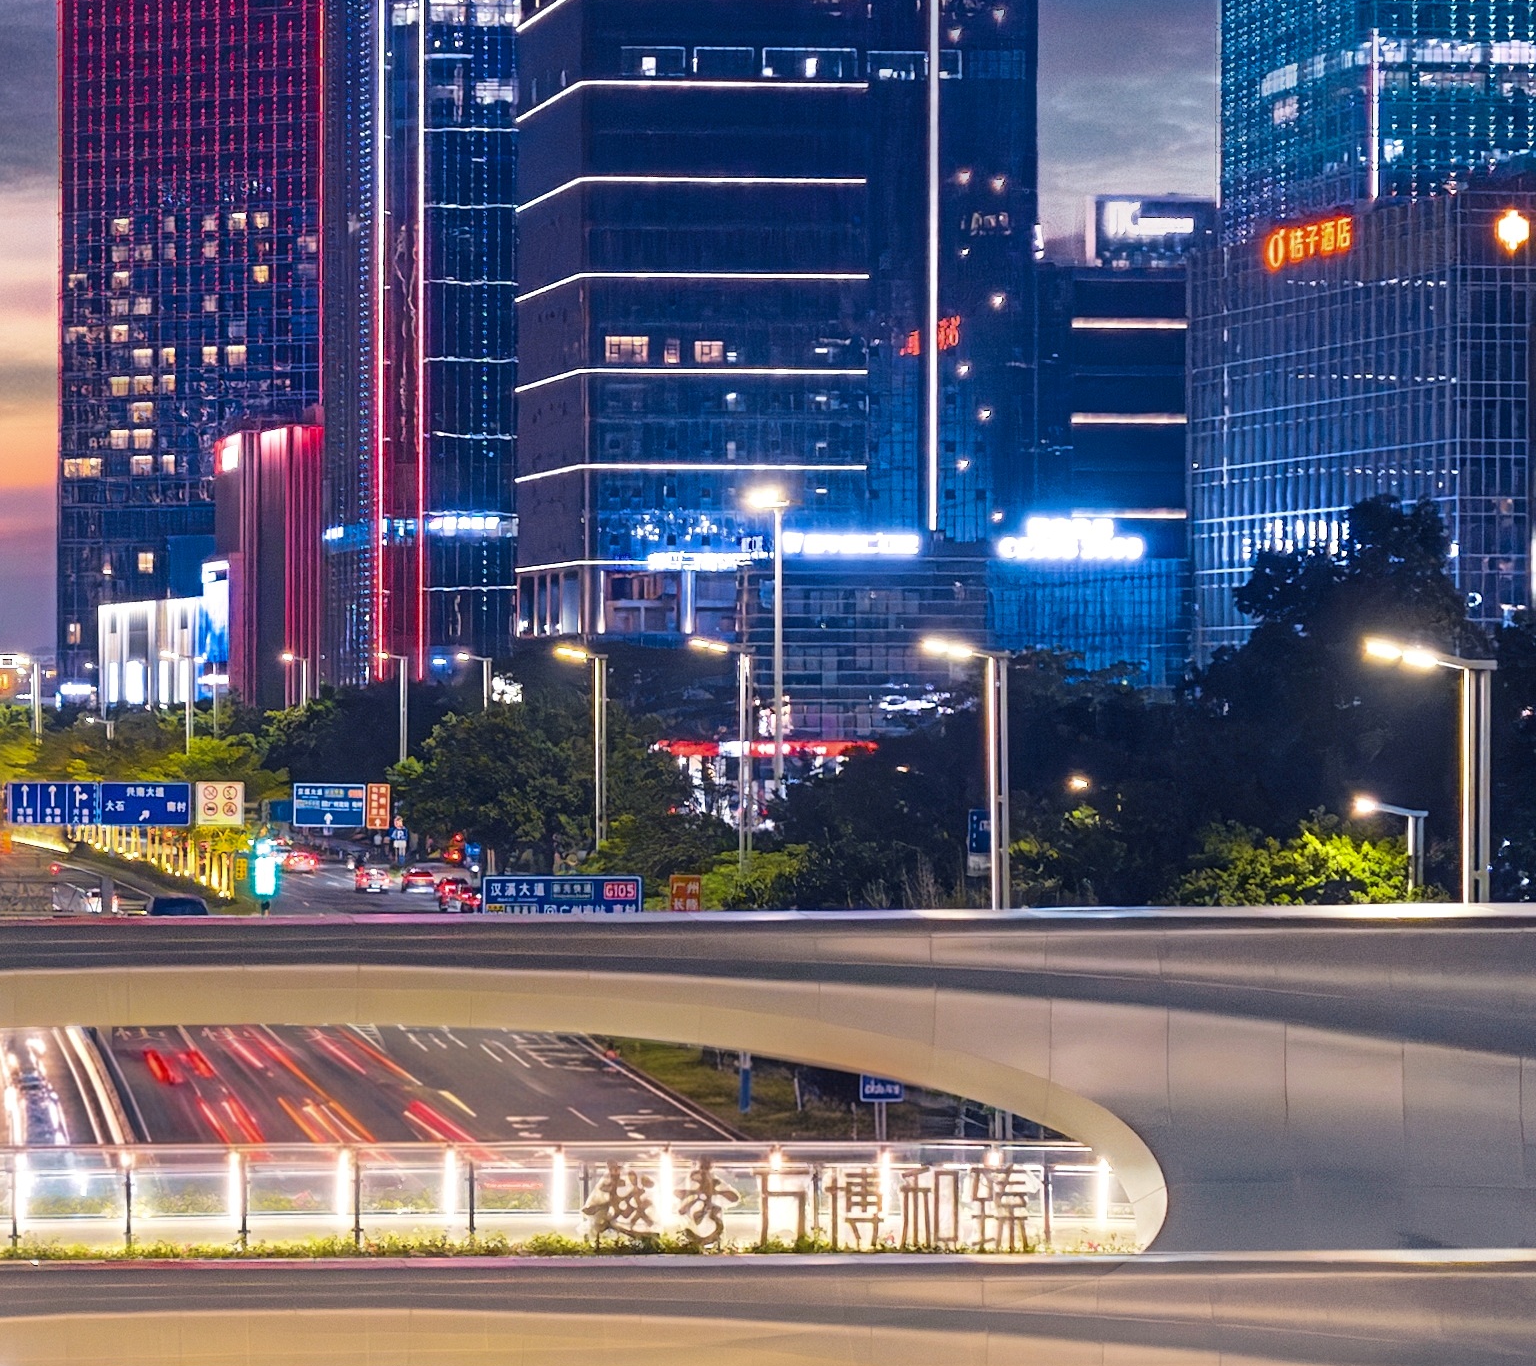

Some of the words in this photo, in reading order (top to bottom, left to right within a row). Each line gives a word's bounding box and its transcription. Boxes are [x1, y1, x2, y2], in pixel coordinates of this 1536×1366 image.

[1290, 215, 1353, 260] 桔子酒店
[126, 786, 165, 798] 兴南大道
[105, 801, 125, 812] 大石
[166, 801, 187, 813] 南村
[490, 882, 546, 897] 汉溪大道
[605, 883, 636, 898] G105
